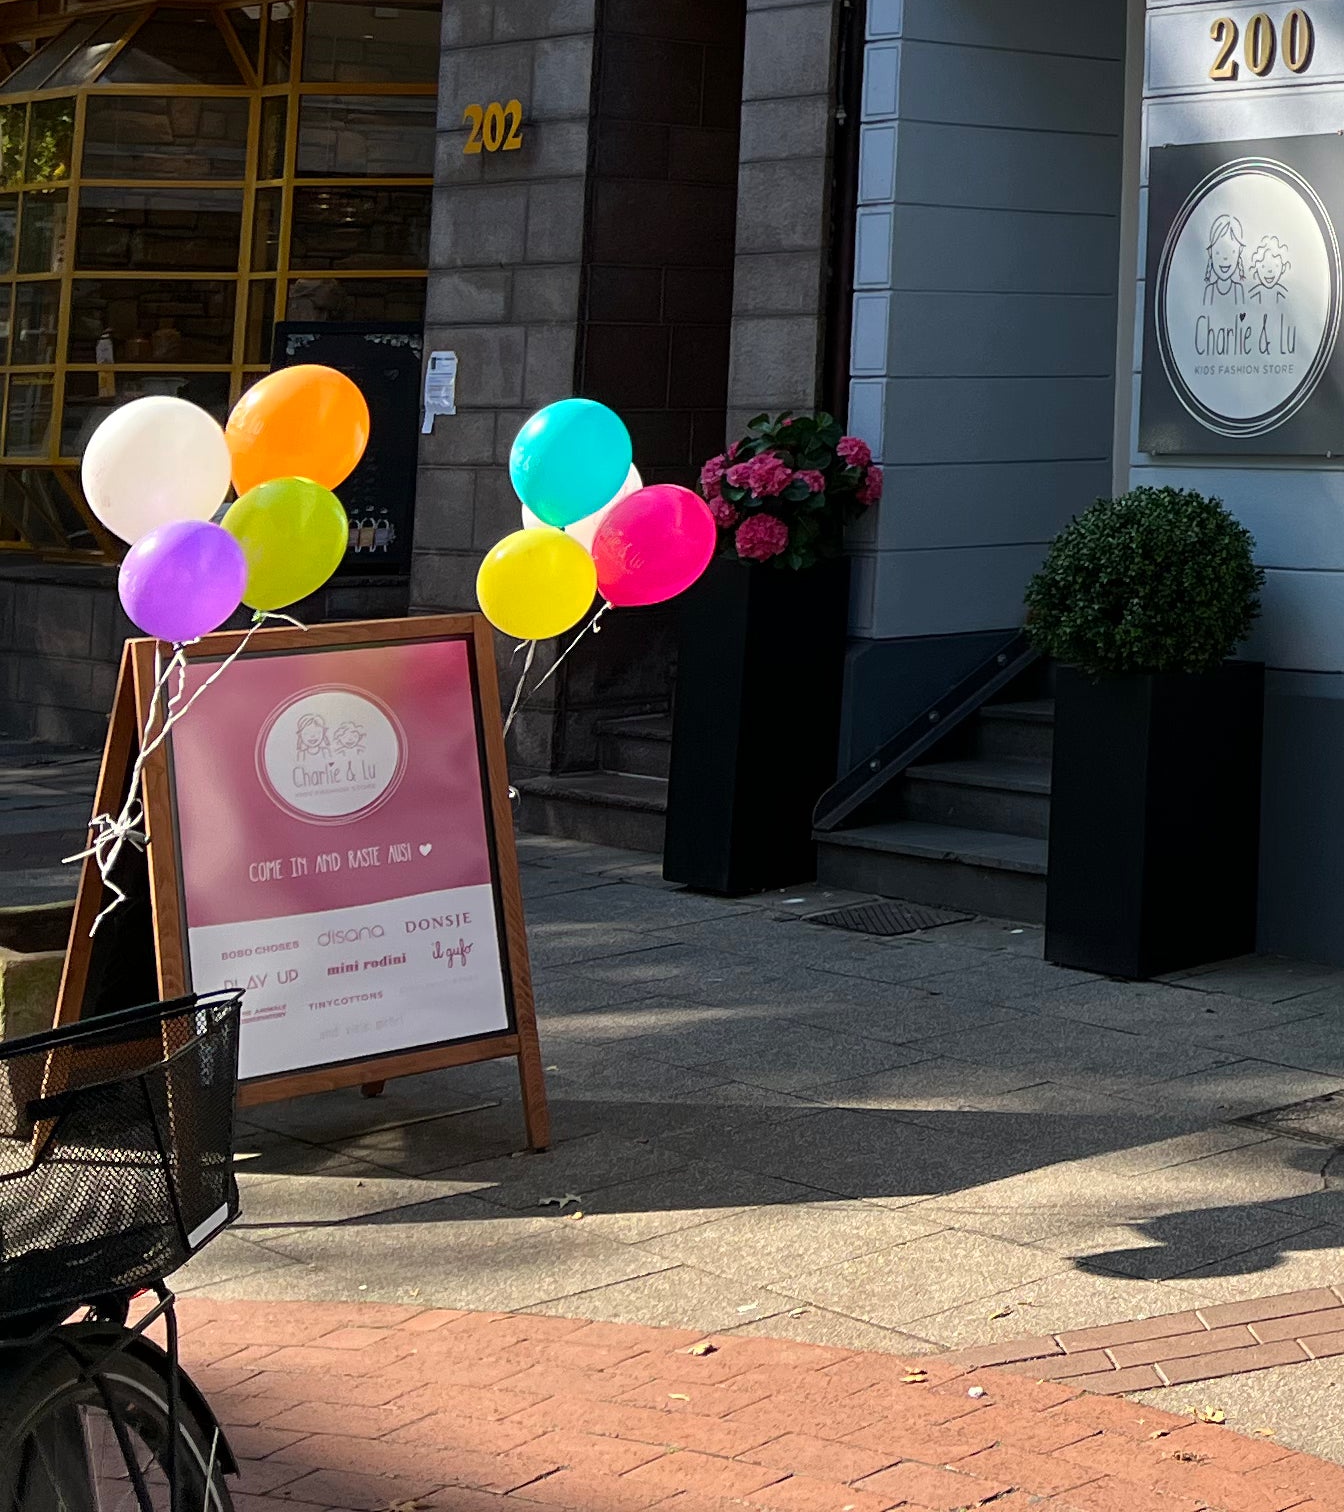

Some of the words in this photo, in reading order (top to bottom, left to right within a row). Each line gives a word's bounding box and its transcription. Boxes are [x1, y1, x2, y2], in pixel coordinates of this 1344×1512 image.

[1209, 8, 1315, 81] 200
[463, 99, 523, 155] 202
[1194, 312, 1252, 356] Charlie
[1258, 313, 1271, 355] &
[1280, 313, 1297, 355] Lu
[1194, 365, 1215, 376] KIDS
[1218, 364, 1260, 375] FASHION
[1262, 364, 1294, 374] STORE
[291, 761, 341, 788] Charlie
[346, 761, 356, 782] &
[362, 762, 376, 780] Lu
[249, 859, 283, 883] COME
[290, 856, 308, 878] IN
[315, 852, 341, 874] AND
[347, 846, 381, 869] RASTE
[317, 924, 385, 947] disana
[404, 912, 473, 934] DONSJE
[221, 950, 253, 961] BOBO
[254, 940, 300, 955] CHOSES
[327, 960, 360, 977] mini
[363, 952, 407, 971] rodini
[308, 990, 384, 1011] TINYCOTTONS
